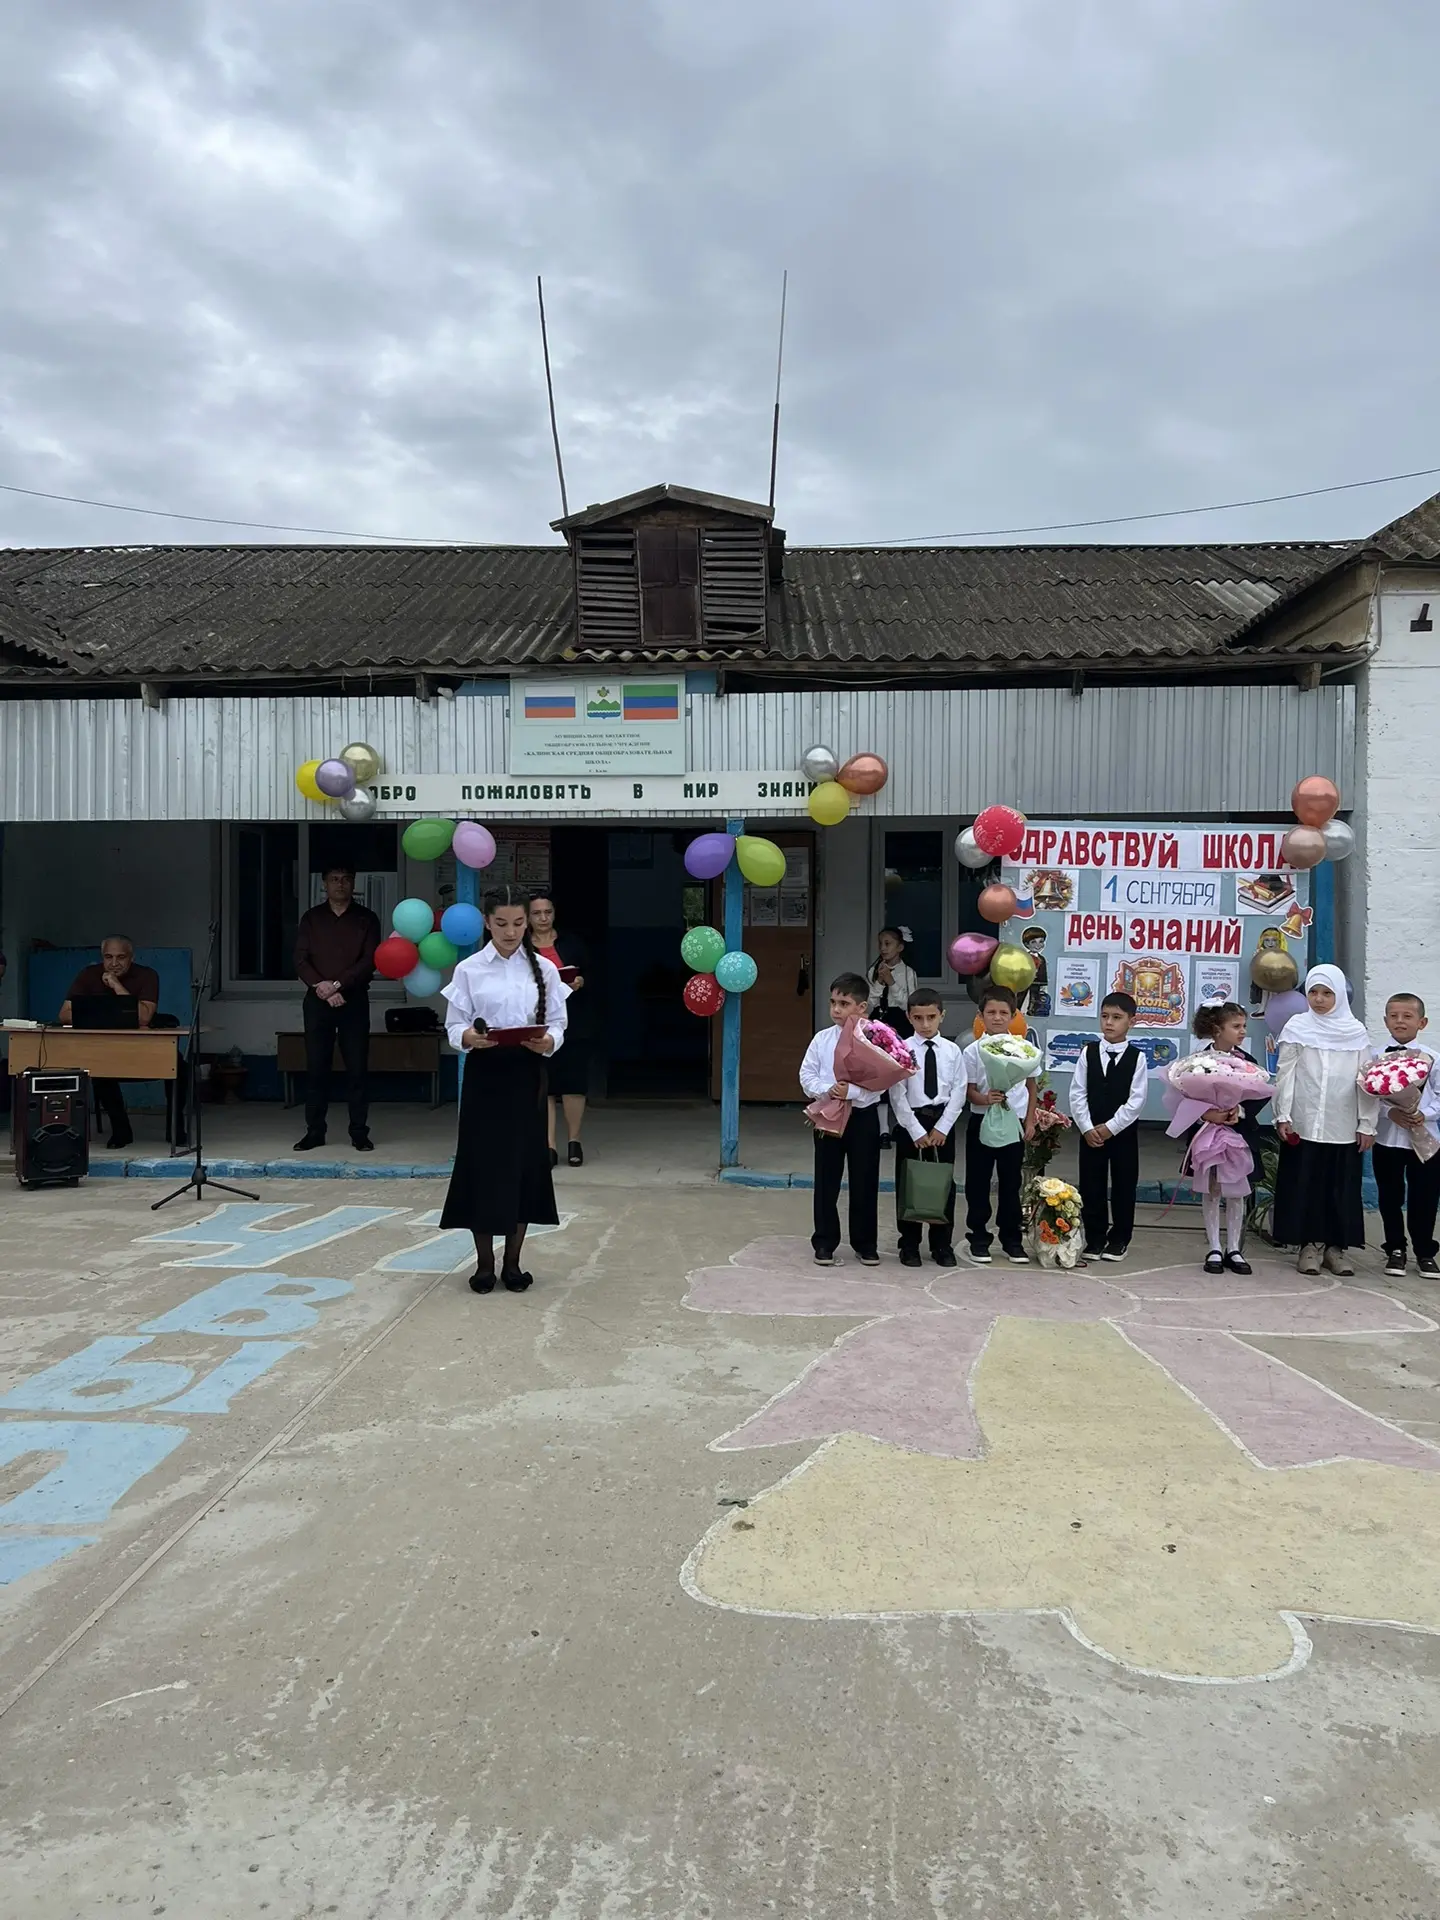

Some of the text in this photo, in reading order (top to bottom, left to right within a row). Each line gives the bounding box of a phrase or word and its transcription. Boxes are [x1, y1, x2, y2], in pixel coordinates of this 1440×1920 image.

[368, 786, 416, 801] ОБРО
[462, 785, 591, 800] ПОЖАЛОВАТЬ
[633, 783, 643, 799] В
[683, 782, 719, 798] МИР
[1104, 874, 1216, 906] 1 СЕНТЯБРЯ
[1136, 997, 1169, 1009] кола
